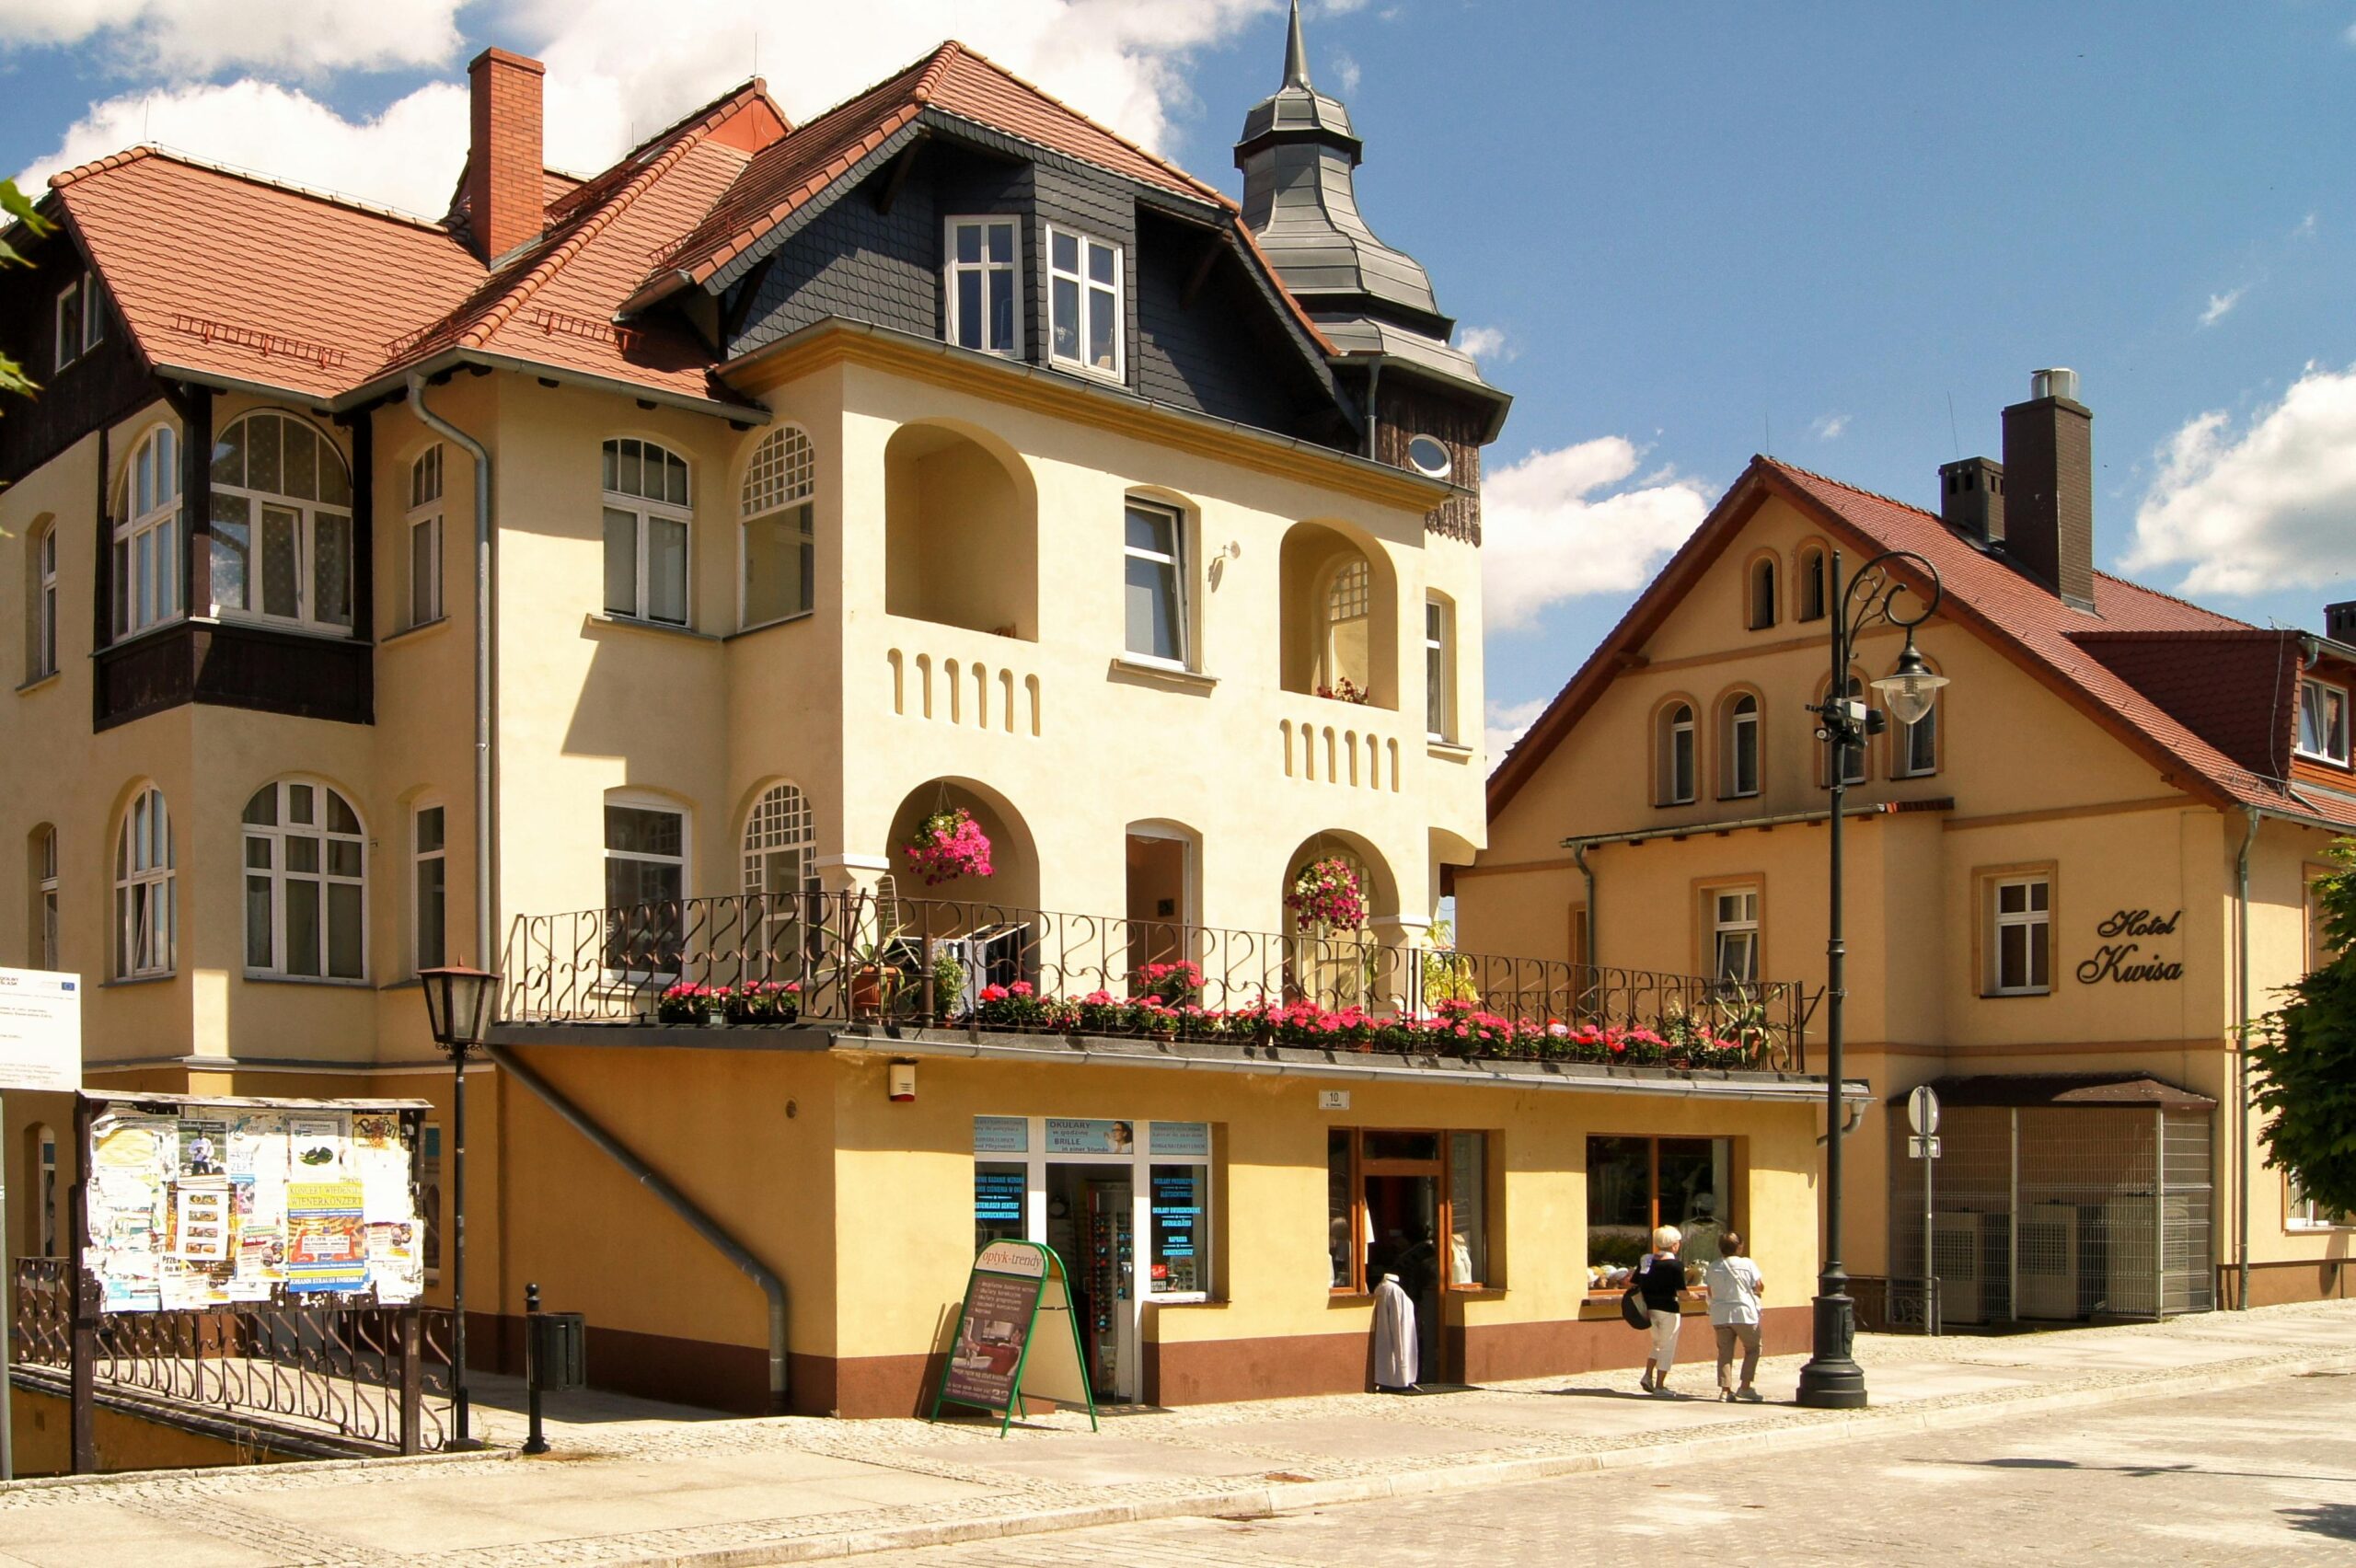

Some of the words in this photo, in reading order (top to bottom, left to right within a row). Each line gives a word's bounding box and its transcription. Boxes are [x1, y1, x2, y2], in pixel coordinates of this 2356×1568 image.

[2096, 909, 2181, 938] Hotel
[2076, 943, 2183, 985] Kwisa
[1330, 1092, 1339, 1102] 10
[1049, 1121, 1091, 1129] OKULARY
[982, 1251, 1043, 1270] optyk-trendy
